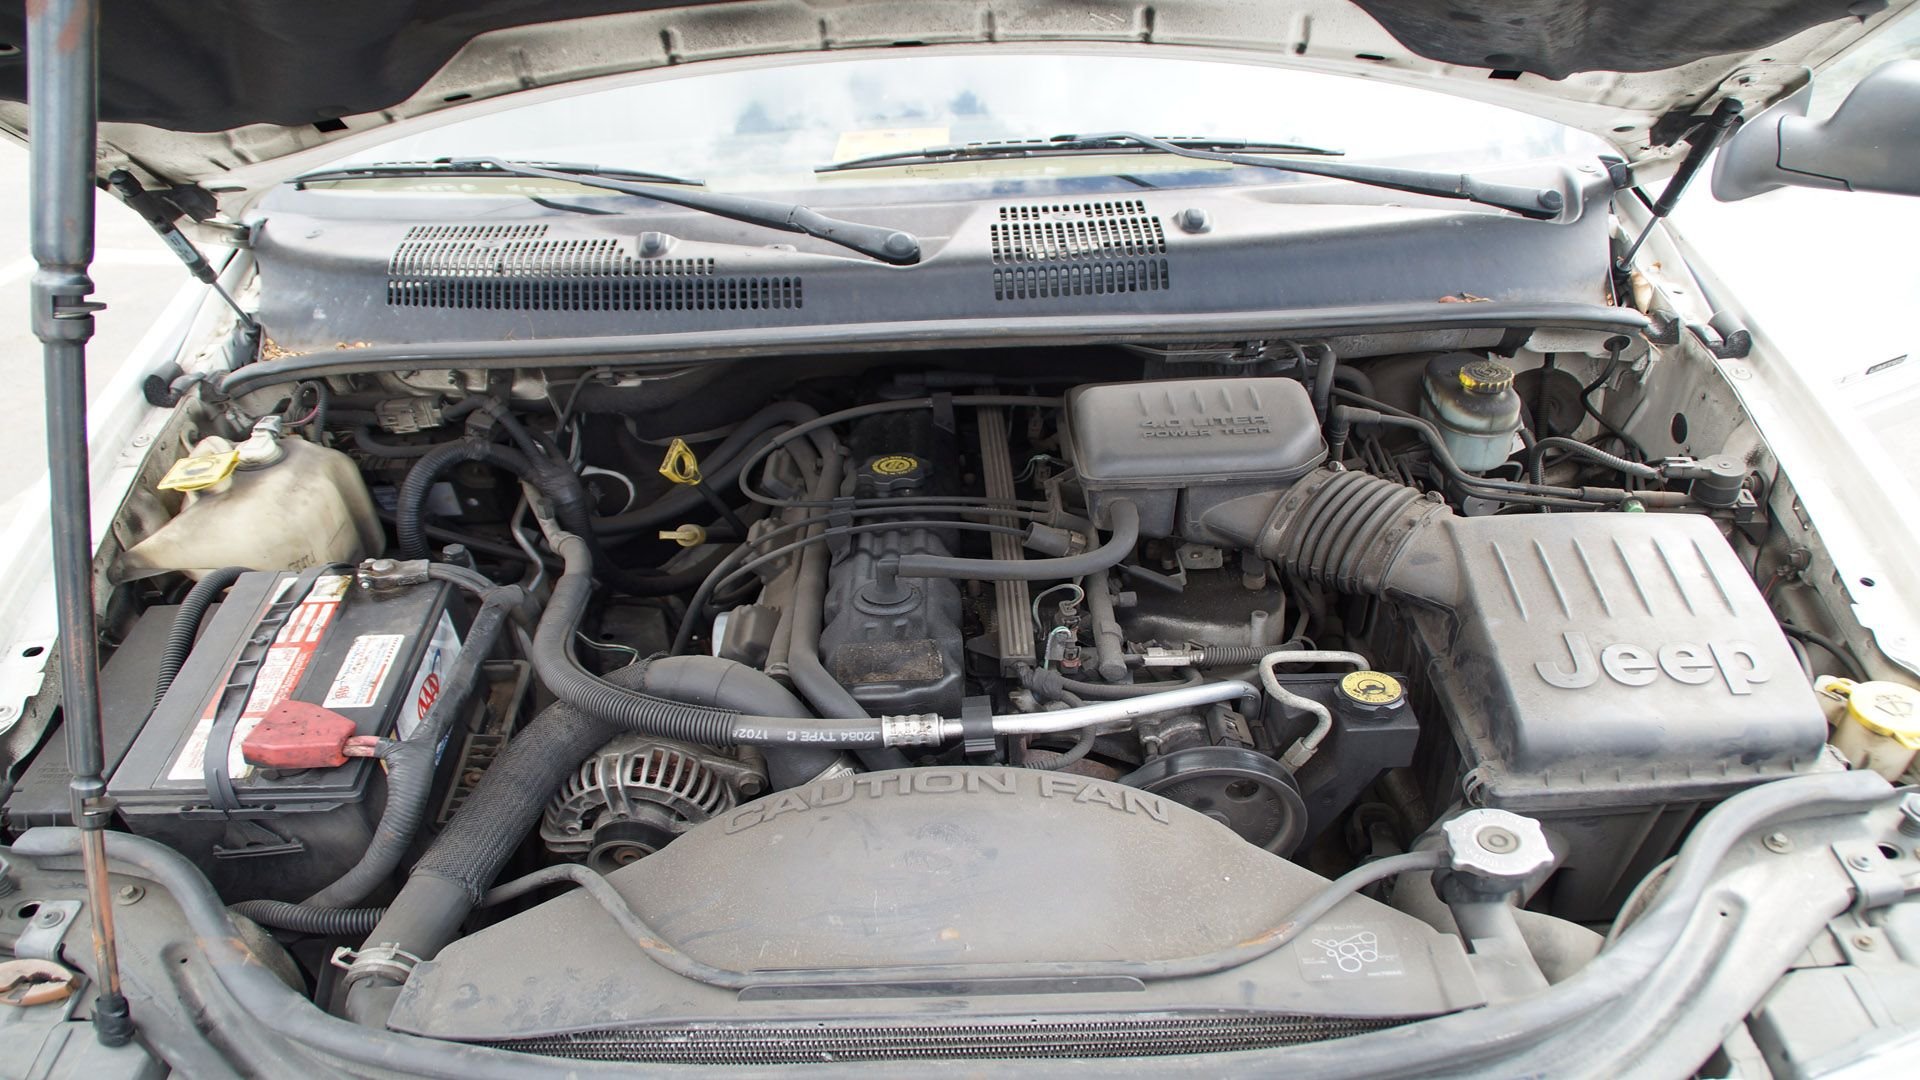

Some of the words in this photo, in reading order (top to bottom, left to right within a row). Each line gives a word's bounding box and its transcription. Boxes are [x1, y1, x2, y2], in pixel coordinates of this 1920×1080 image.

[1140, 416, 1186, 429] 4.0
[1192, 415, 1271, 428] LITER
[1143, 428, 1211, 438] POWER
[1221, 427, 1272, 435] TECH
[1534, 631, 1771, 695] Jeep
[786, 730, 797, 742] C
[800, 730, 837, 742] TYPE
[723, 768, 1017, 835] CAUTION
[1038, 773, 1170, 825] FAN
